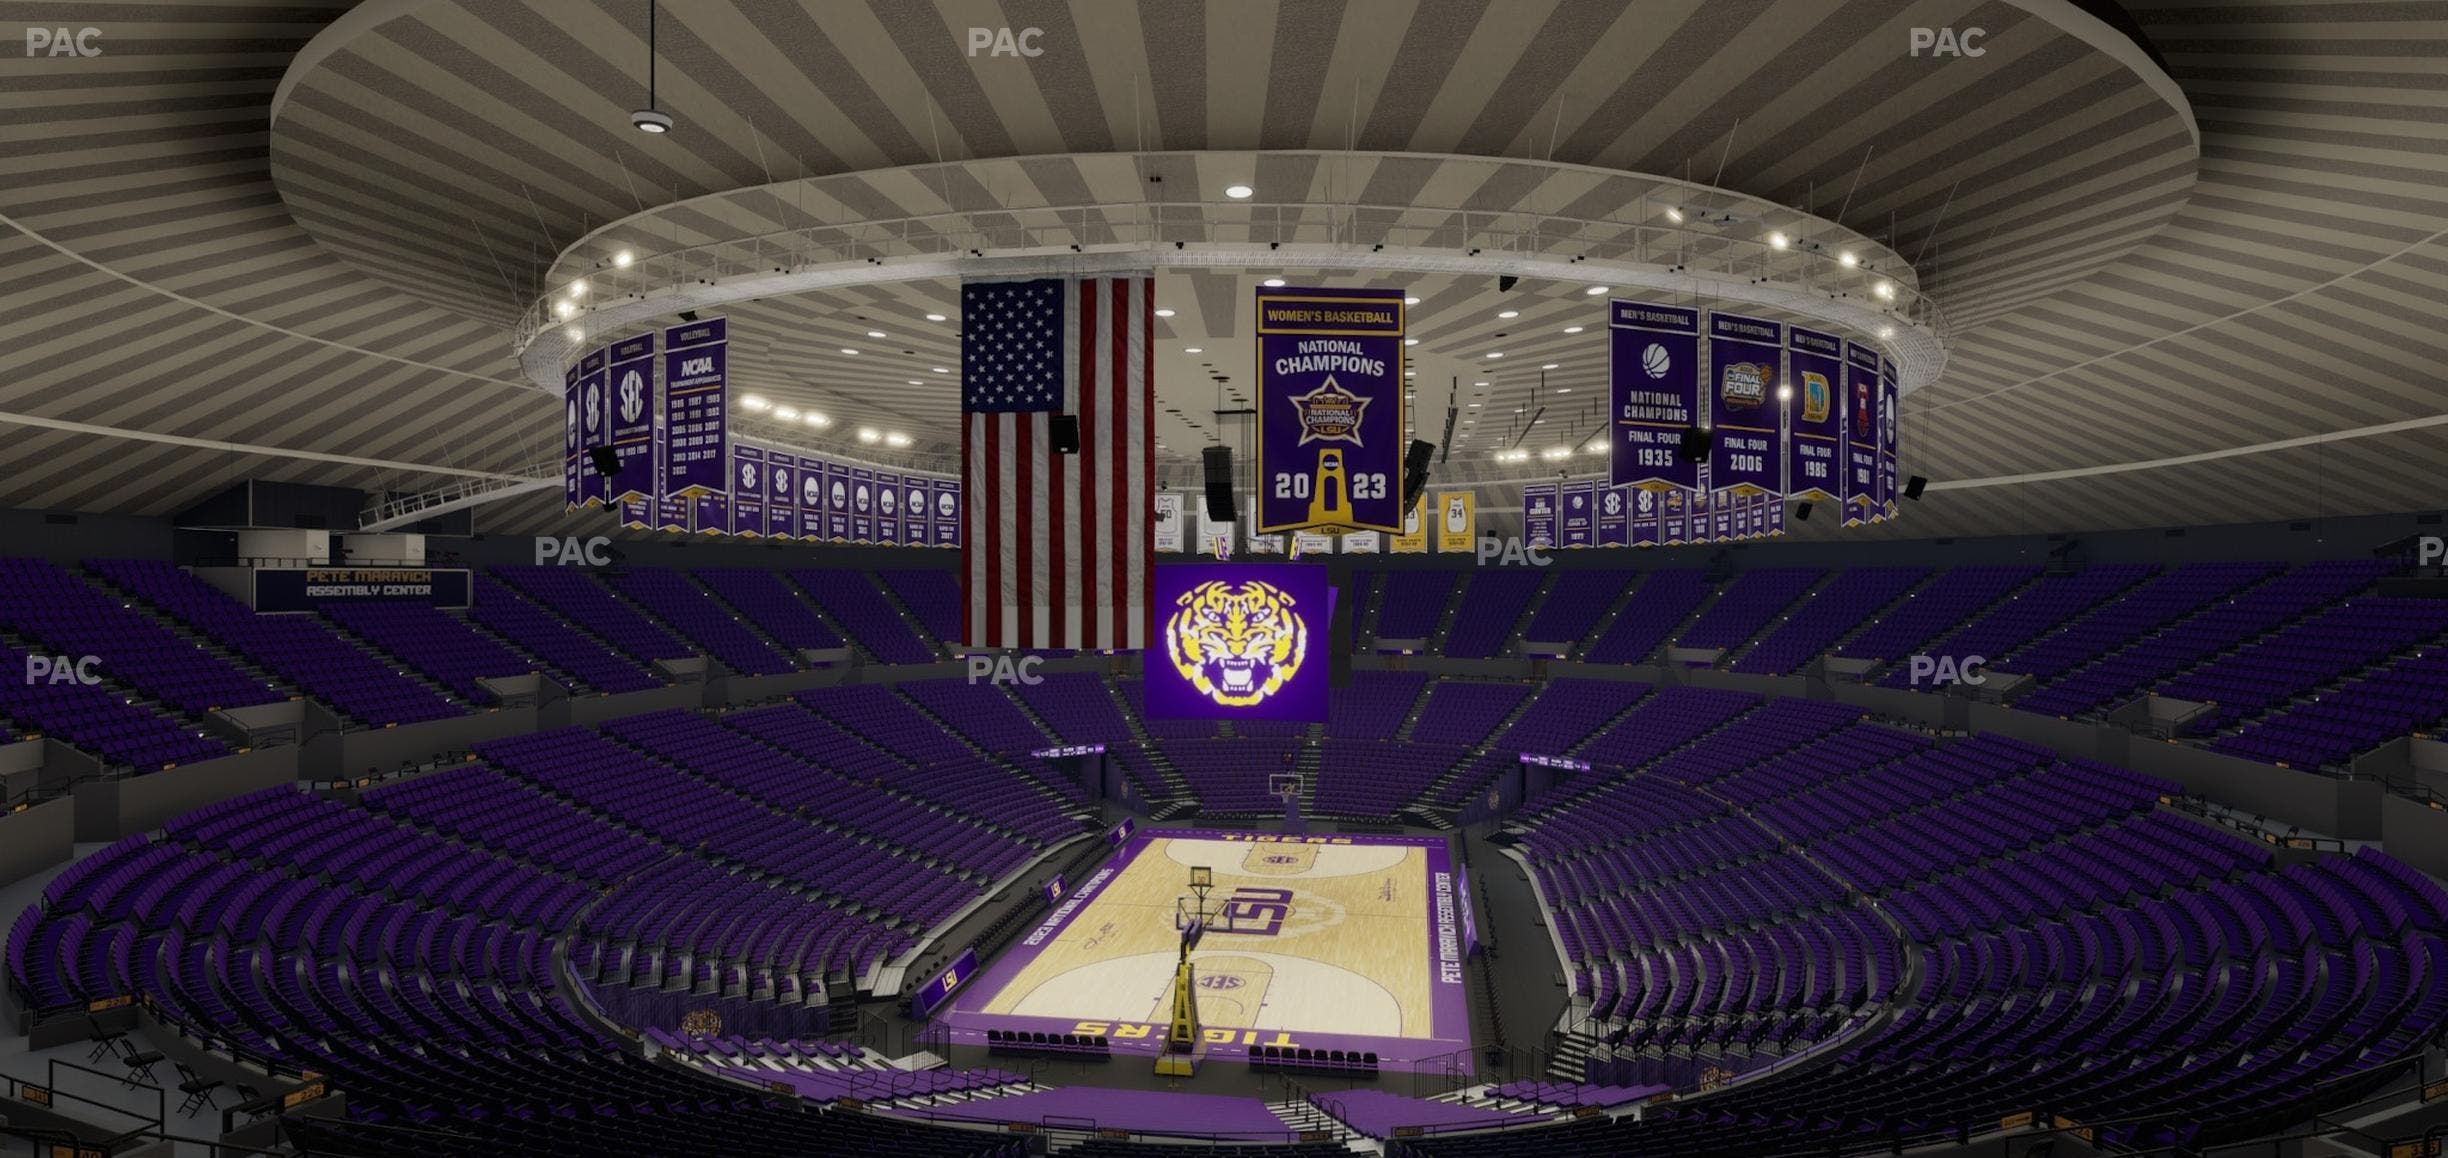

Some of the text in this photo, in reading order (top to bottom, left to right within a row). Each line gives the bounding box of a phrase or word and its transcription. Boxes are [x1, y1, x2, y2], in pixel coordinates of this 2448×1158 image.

[1268, 309, 1394, 324] WOMEN'S BASKETBALL
[1620, 308, 1690, 326] MEN'S BASKETBALL
[1738, 323, 1775, 338] BASKETBALL
[1298, 340, 1364, 355] NATIONAL
[681, 356, 712, 378] NCAA
[1275, 355, 1385, 377] CHAMPIONS
[1735, 372, 1761, 385] FINAL
[620, 369, 644, 424] SEC
[1726, 381, 1760, 396] FOUR
[1630, 390, 1682, 406] NATIONAL
[1305, 415, 1356, 425] CHAMPIONS
[1311, 408, 1351, 417] NATIONAL
[1624, 405, 1688, 422] CHAMPIONS
[1628, 430, 1681, 445] FINAL FOUR
[1724, 436, 1768, 451] FINAL FOUR
[1638, 449, 1673, 466] 1935
[1799, 444, 1832, 458] FINAL FOUR
[1730, 454, 1763, 472] 2006
[1805, 460, 1827, 478] 1986
[1275, 472, 1387, 499] 20 23
[1604, 492, 1621, 515] SEC
[1451, 508, 1463, 519] 34
[1321, 527, 1340, 535] LSU
[307, 570, 432, 583] PETE MARAVICH
[306, 584, 432, 597] ASSEMBLY CENTER
[1222, 887, 1294, 936] LSU
[1022, 925, 1051, 946] 2023
[942, 968, 957, 992] LSU
[1440, 961, 1463, 984] PETE
[1201, 975, 1241, 990] SEC
[1071, 1021, 1300, 1048] TIGRS
